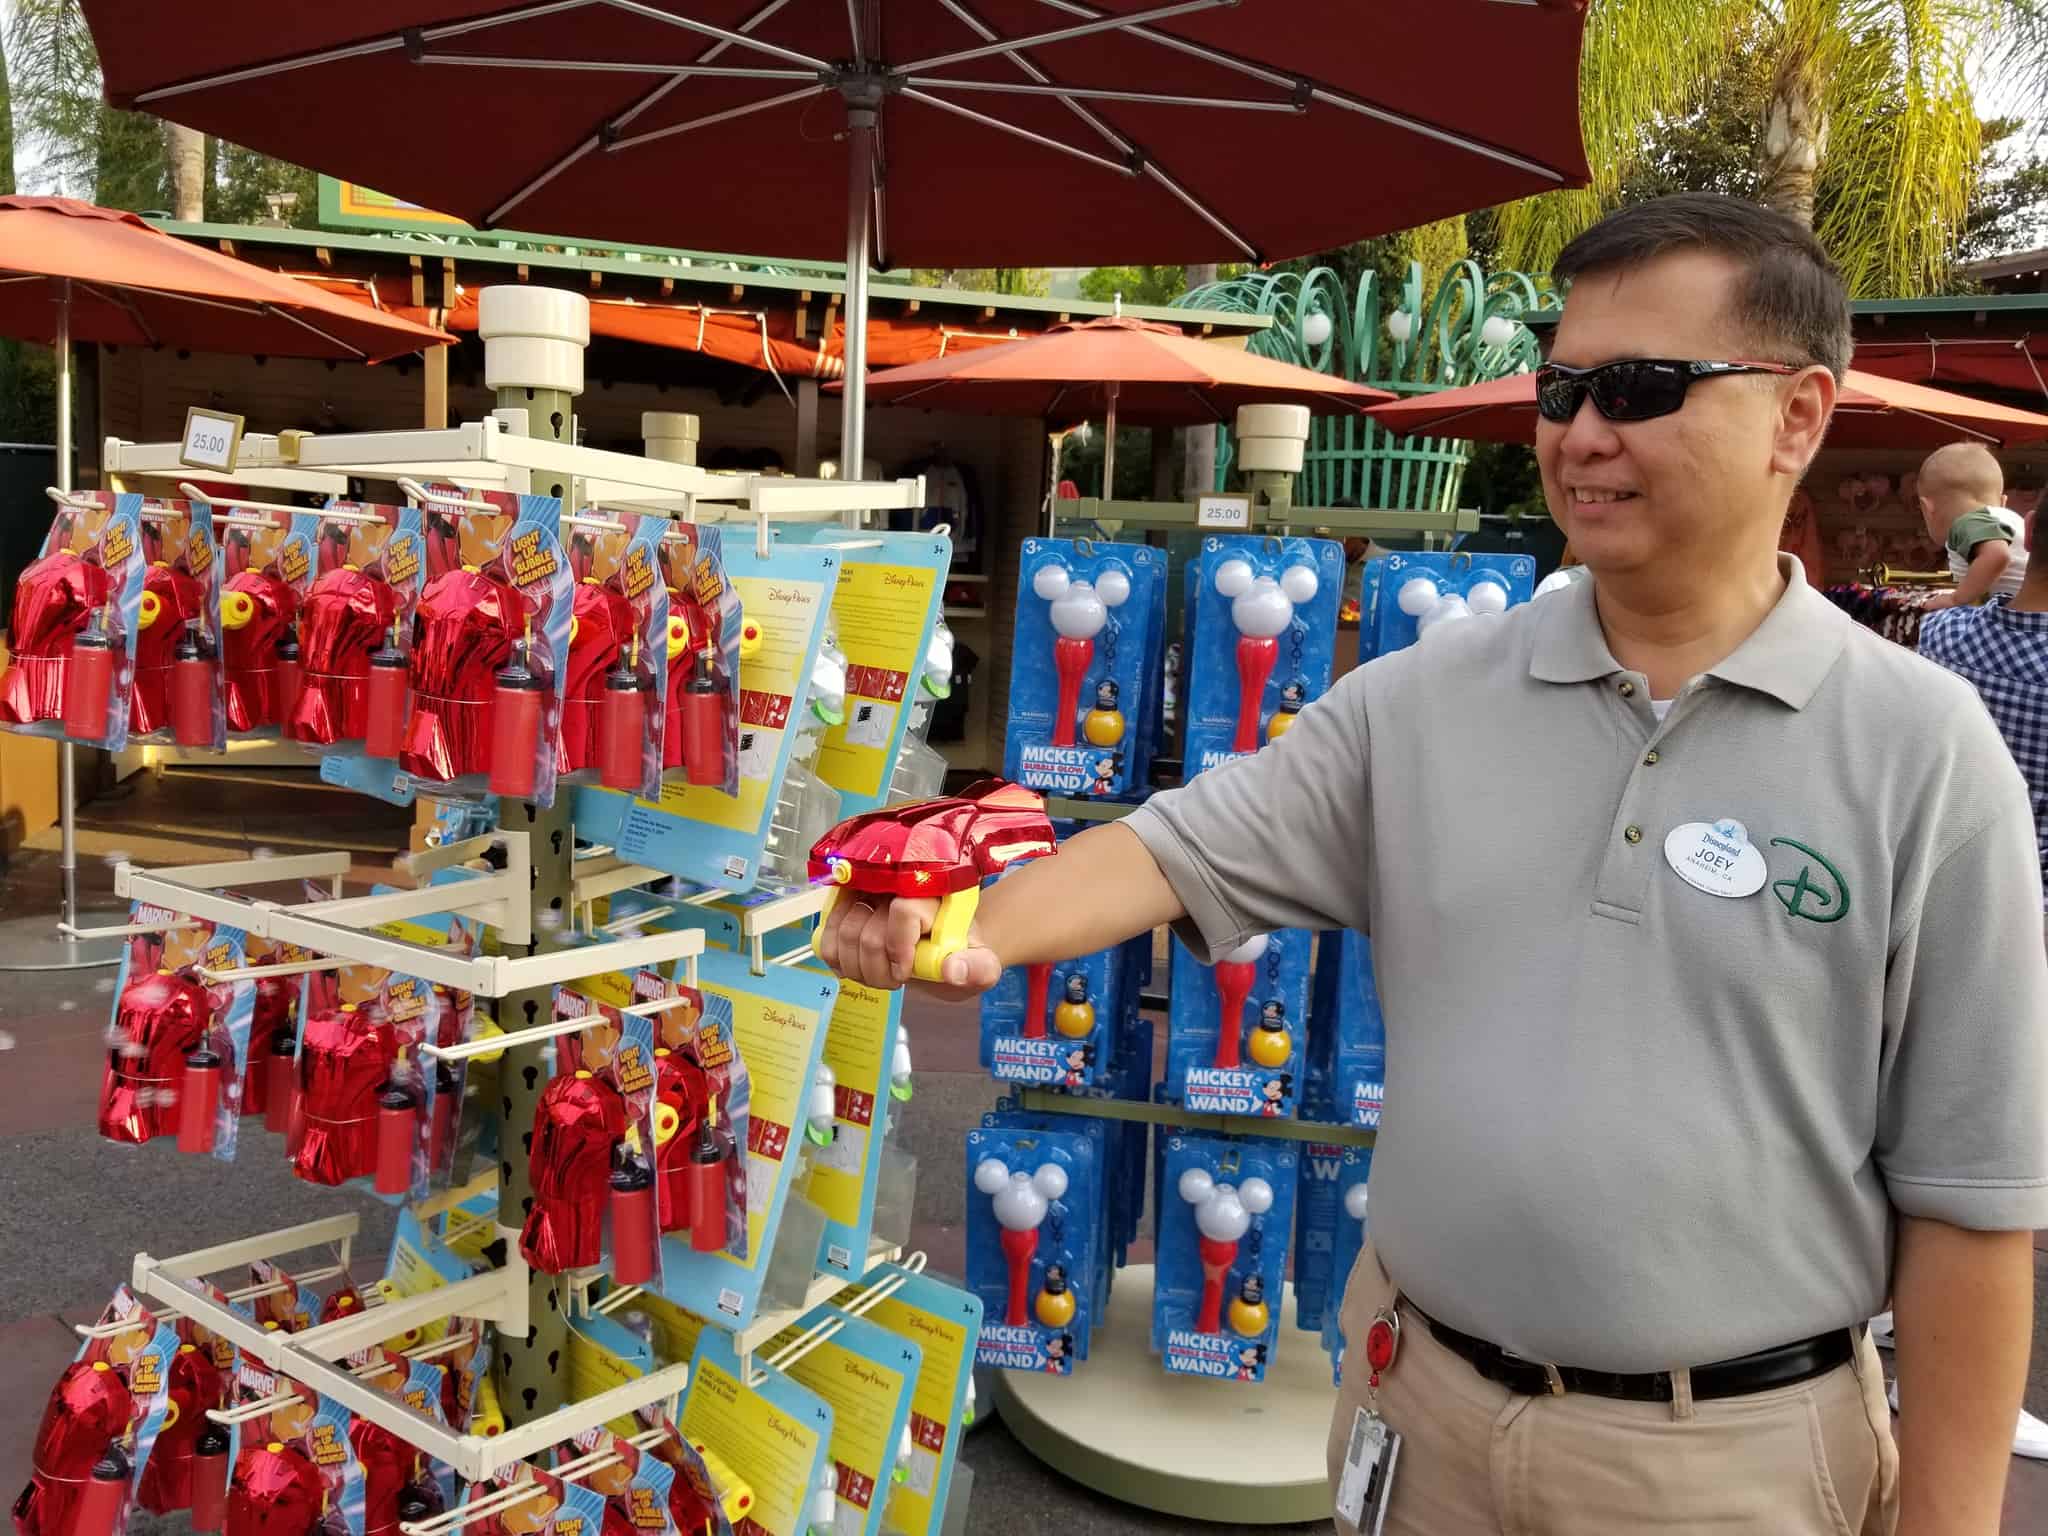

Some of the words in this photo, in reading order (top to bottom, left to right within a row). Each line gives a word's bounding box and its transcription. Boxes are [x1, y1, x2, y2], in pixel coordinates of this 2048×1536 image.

[193, 433, 225, 453] 25.00
[1207, 508, 1241, 519] 25.00
[512, 531, 540, 552] LIGHT
[933, 544, 944, 555] 3+
[1026, 540, 1043, 554] 3+
[1206, 537, 1225, 553] 3+
[523, 545, 537, 557] UP
[515, 550, 552, 573] BUBBLE
[822, 557, 834, 568] 3+
[1389, 555, 1408, 570] 3+
[517, 561, 557, 586] GAUNTLET
[1023, 747, 1088, 765] MICKEY
[1023, 763, 1056, 772] BUBBLE
[1056, 765, 1084, 774] GLOW
[1026, 772, 1081, 789] WAND
[1702, 833, 1741, 857] Disneyland
[1695, 848, 1735, 872] JOEY
[820, 987, 831, 998] 3+
[994, 1038, 1059, 1057] MICKEY
[997, 1063, 1051, 1081] WAND
[1186, 1067, 1254, 1087] MICKEY
[1190, 1096, 1249, 1113] WAND
[969, 1131, 986, 1145] 3+
[1170, 1138, 1187, 1151] 3+
[963, 1303, 975, 1315] 3+
[978, 1326, 1038, 1345] MICKEY
[1168, 1331, 1232, 1353] MICKEY
[901, 1350, 912, 1361] 3+
[979, 1352, 1034, 1369] WAND
[1171, 1357, 1226, 1376] WAND
[240, 1366, 274, 1394] MARVEL
[556, 1519, 583, 1533] LIGHT
